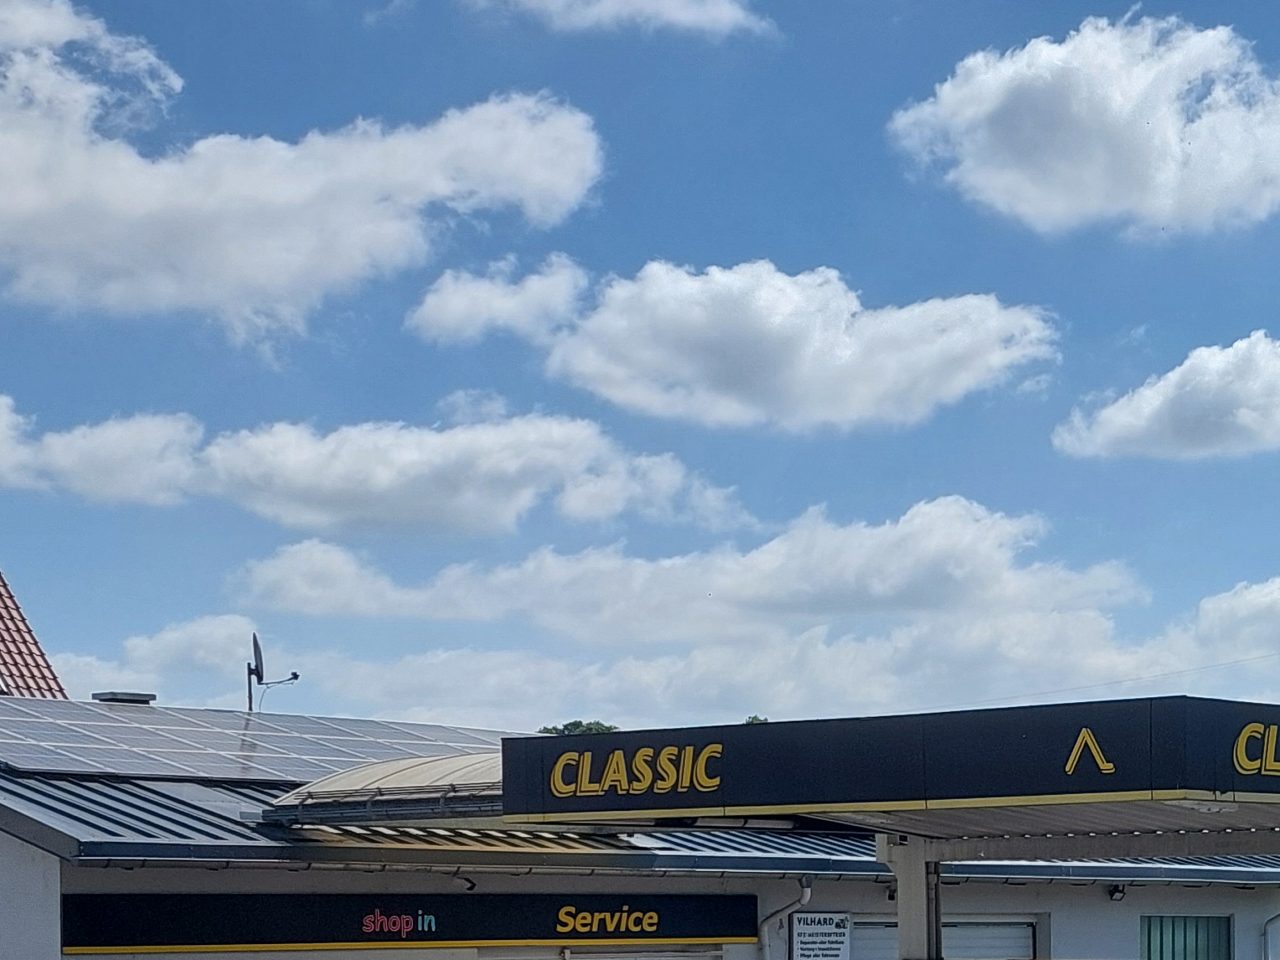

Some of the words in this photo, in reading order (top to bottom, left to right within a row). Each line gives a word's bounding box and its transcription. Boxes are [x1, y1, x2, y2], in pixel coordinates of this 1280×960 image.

[550, 743, 723, 799] CLASSIC
[362, 909, 413, 938] shop
[418, 910, 436, 932] in
[556, 905, 659, 933] Service
[797, 917, 834, 926] VILHARD
